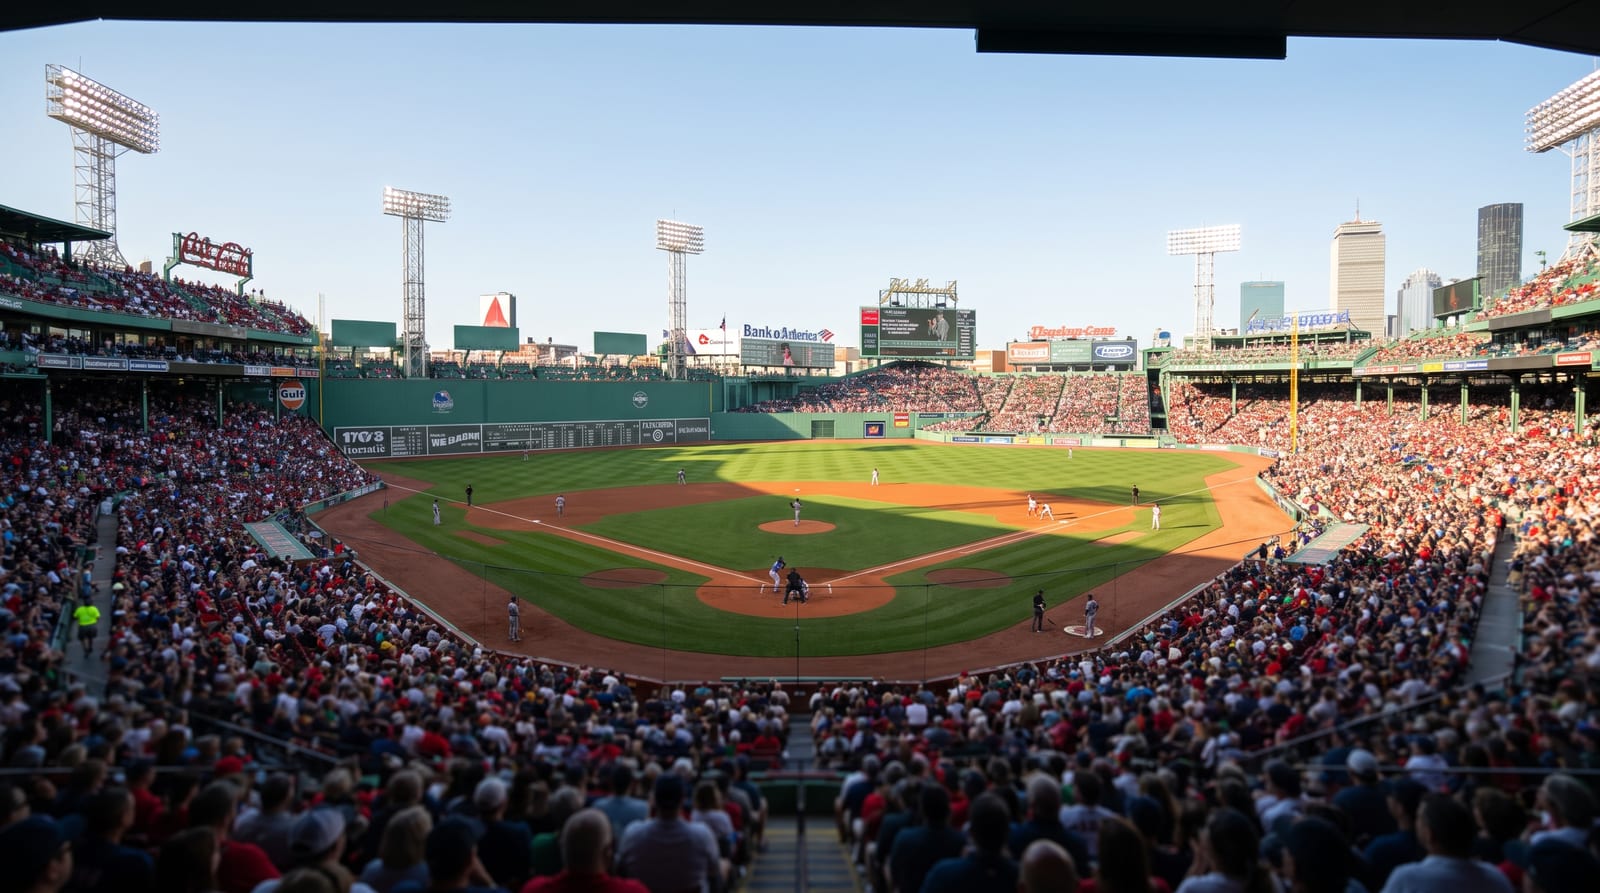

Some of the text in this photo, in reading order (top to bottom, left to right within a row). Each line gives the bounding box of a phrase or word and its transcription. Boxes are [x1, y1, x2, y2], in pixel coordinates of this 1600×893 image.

[744, 324, 772, 339] Bank
[281, 389, 304, 398] Gulf
[431, 438, 447, 447] WE
